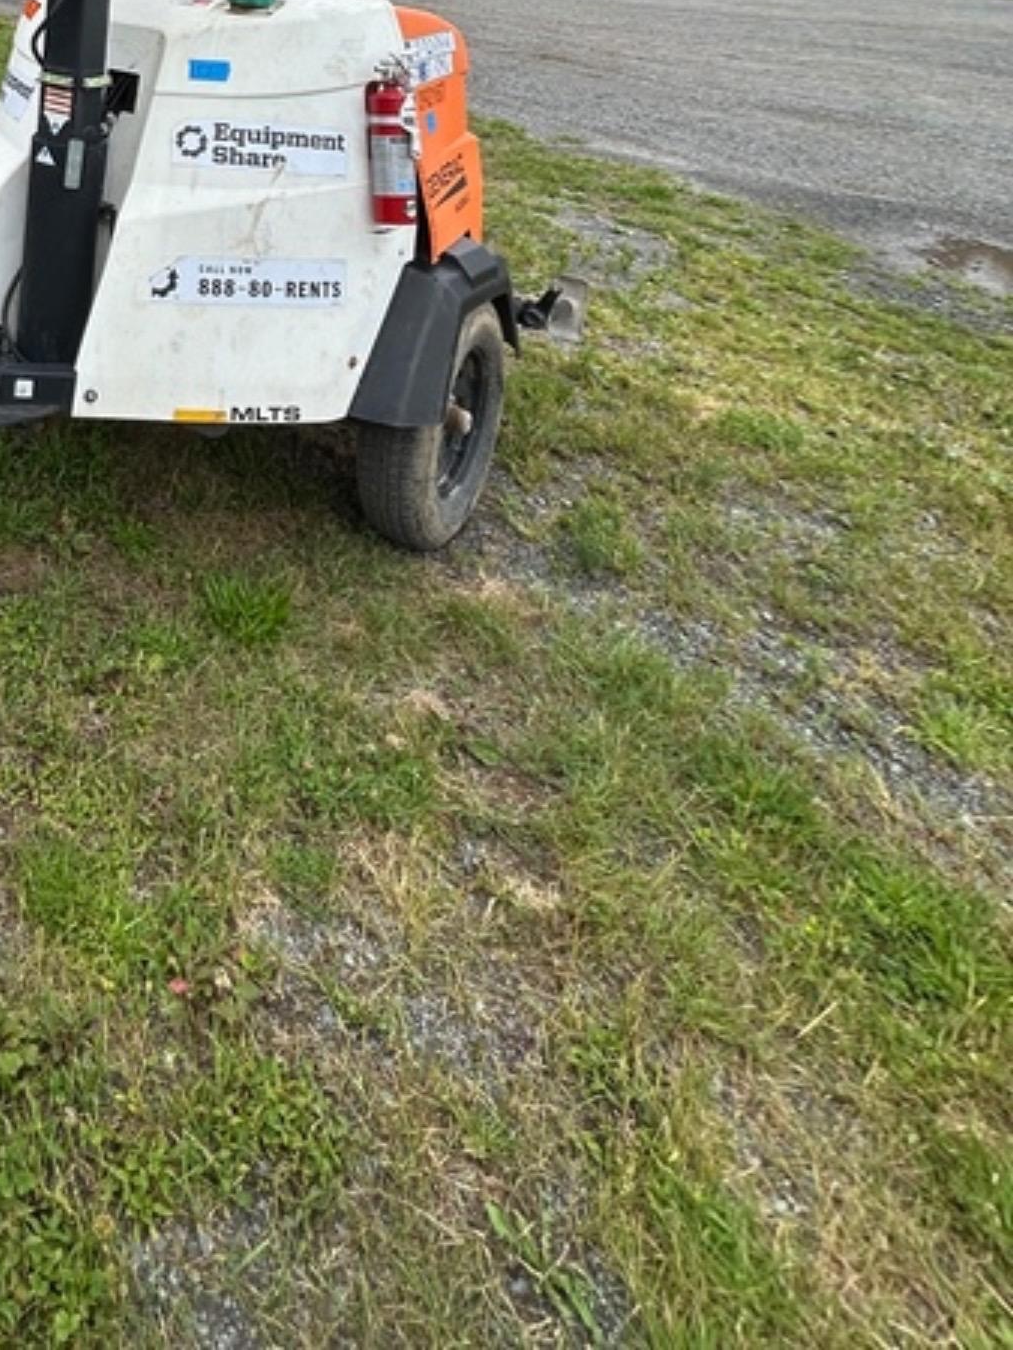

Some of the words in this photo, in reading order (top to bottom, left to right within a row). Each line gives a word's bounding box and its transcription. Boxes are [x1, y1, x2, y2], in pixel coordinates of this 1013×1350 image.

[212, 122, 346, 153] Equipment
[198, 278, 343, 299] 888-80-RENTS
[229, 406, 301, 422] MLTS
